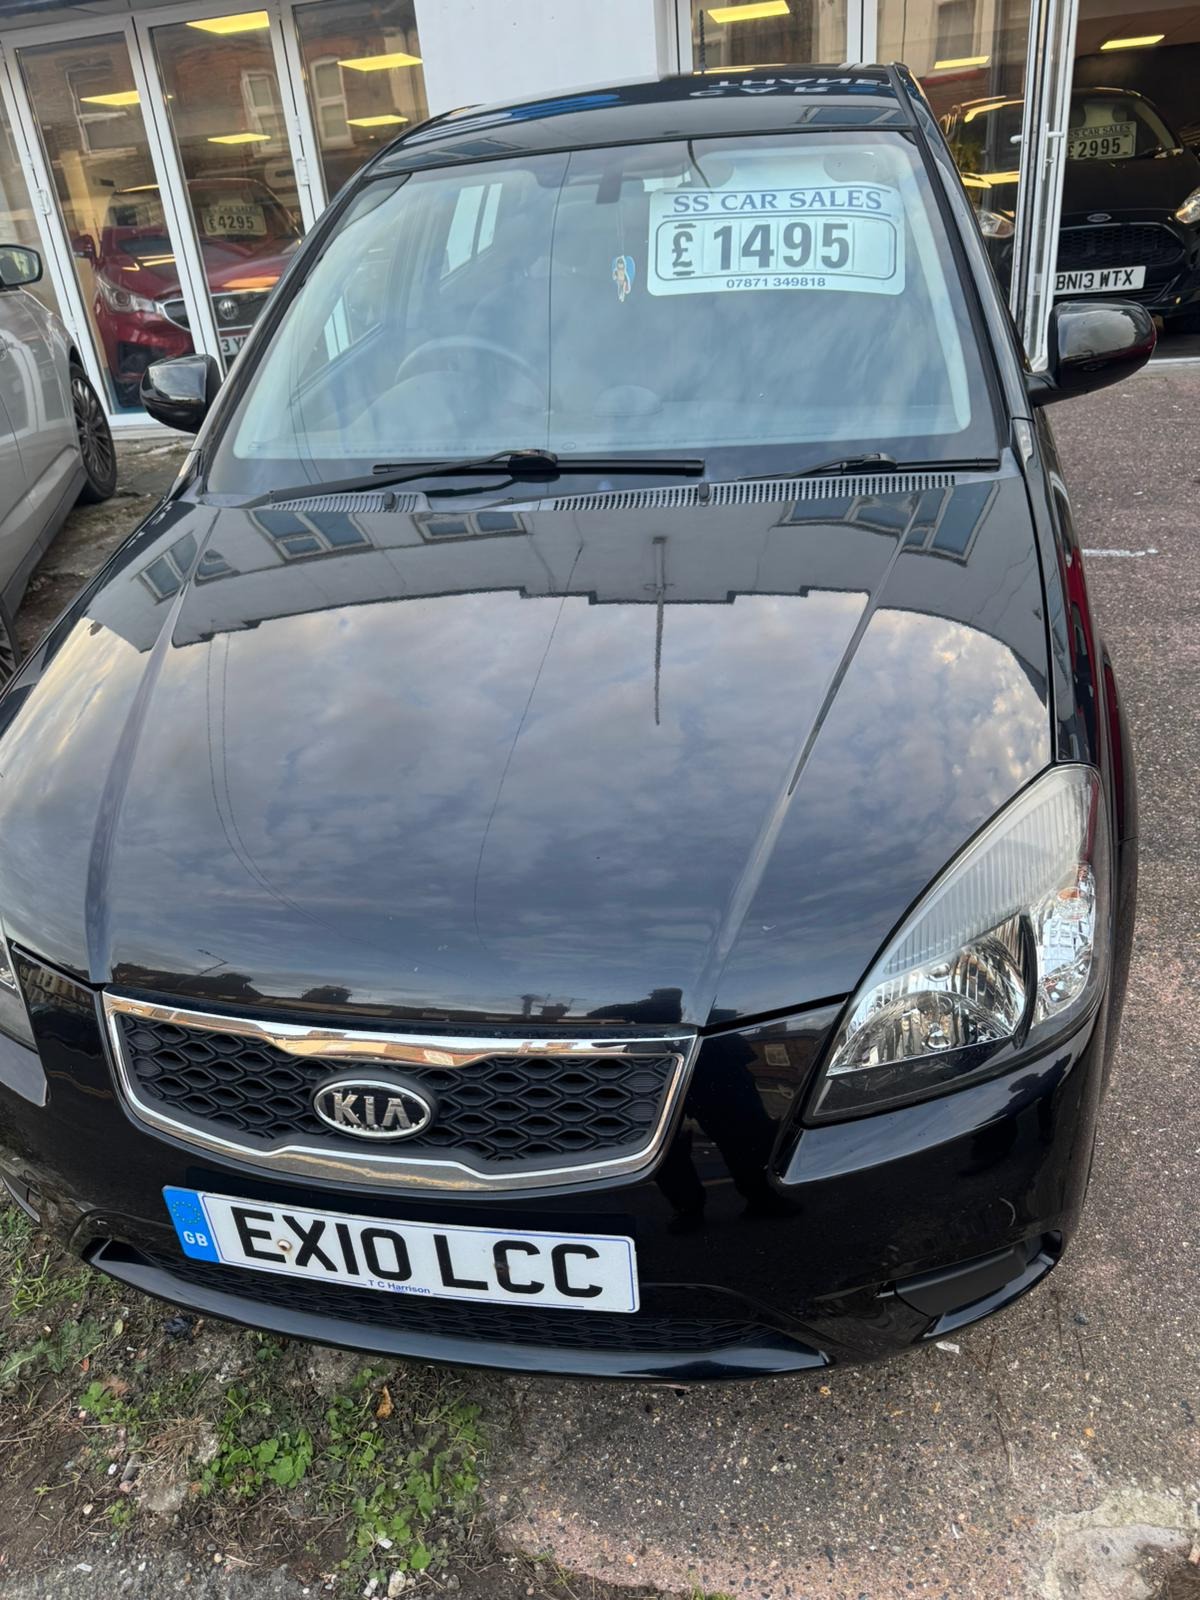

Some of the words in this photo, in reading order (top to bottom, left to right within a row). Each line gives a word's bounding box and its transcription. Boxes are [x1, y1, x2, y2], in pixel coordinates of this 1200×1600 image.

[1082, 128, 1100, 138] CAR
[1103, 125, 1131, 135] SALES
[673, 194, 709, 213] SS
[721, 193, 778, 211] CAR
[789, 190, 883, 210] SALES
[726, 278, 769, 289] 07871
[773, 277, 827, 288] 349818
[1055, 272, 1095, 291] BN13
[1100, 269, 1135, 288] WTX
[332, 1091, 412, 1129] KIA
[183, 1230, 209, 1247] GB
[230, 1205, 413, 1283] EX10
[432, 1233, 604, 1299] LCC
[367, 1279, 375, 1287] T
[377, 1281, 386, 1289] C
[387, 1282, 432, 1294] Harrison
